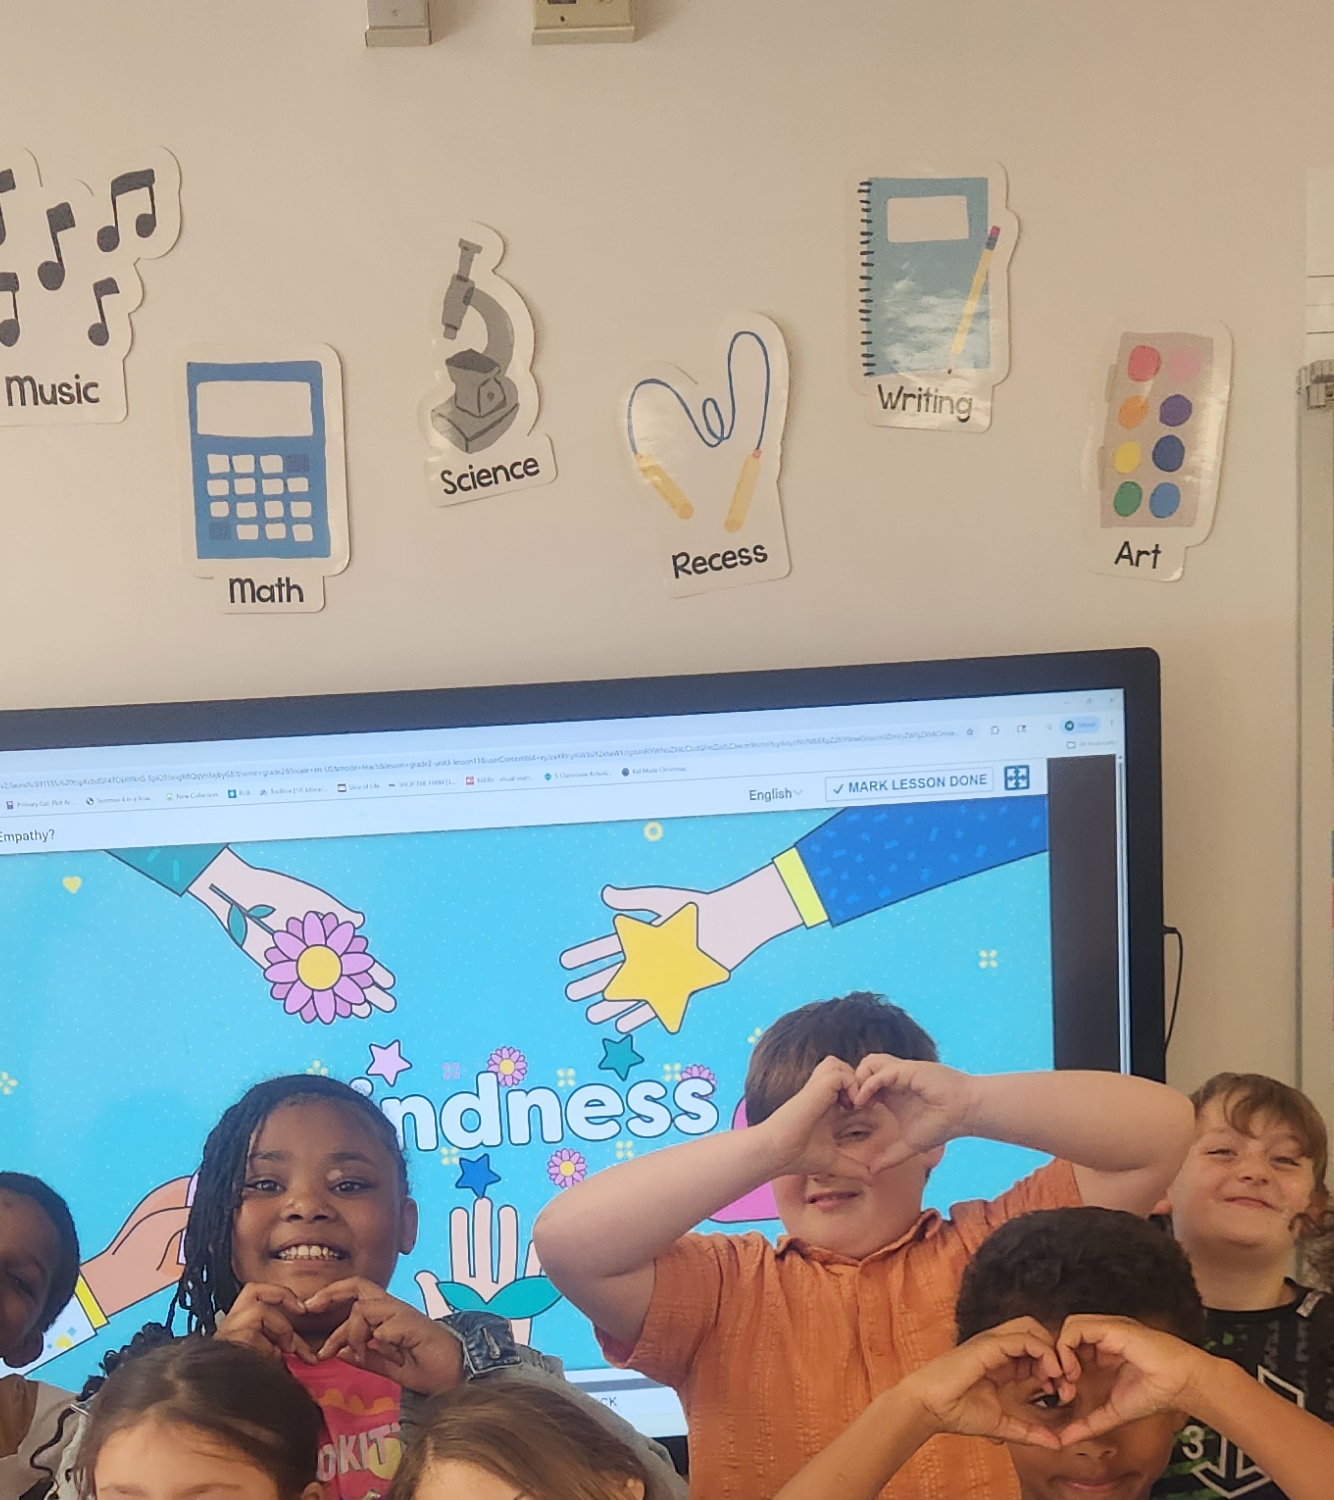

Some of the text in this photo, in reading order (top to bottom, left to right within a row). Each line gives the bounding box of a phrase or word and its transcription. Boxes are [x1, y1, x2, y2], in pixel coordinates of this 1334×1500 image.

[5, 373, 100, 408] Music
[877, 384, 974, 422] Writing
[440, 452, 541, 496] Science
[671, 541, 770, 579] Recess
[1114, 541, 1164, 570] Art
[228, 577, 304, 605] Math
[749, 787, 792, 801] English
[848, 773, 987, 794] MARK LESSON DONE
[348, 1072, 719, 1152] ndness
[1182, 1425, 1204, 1459] 3
